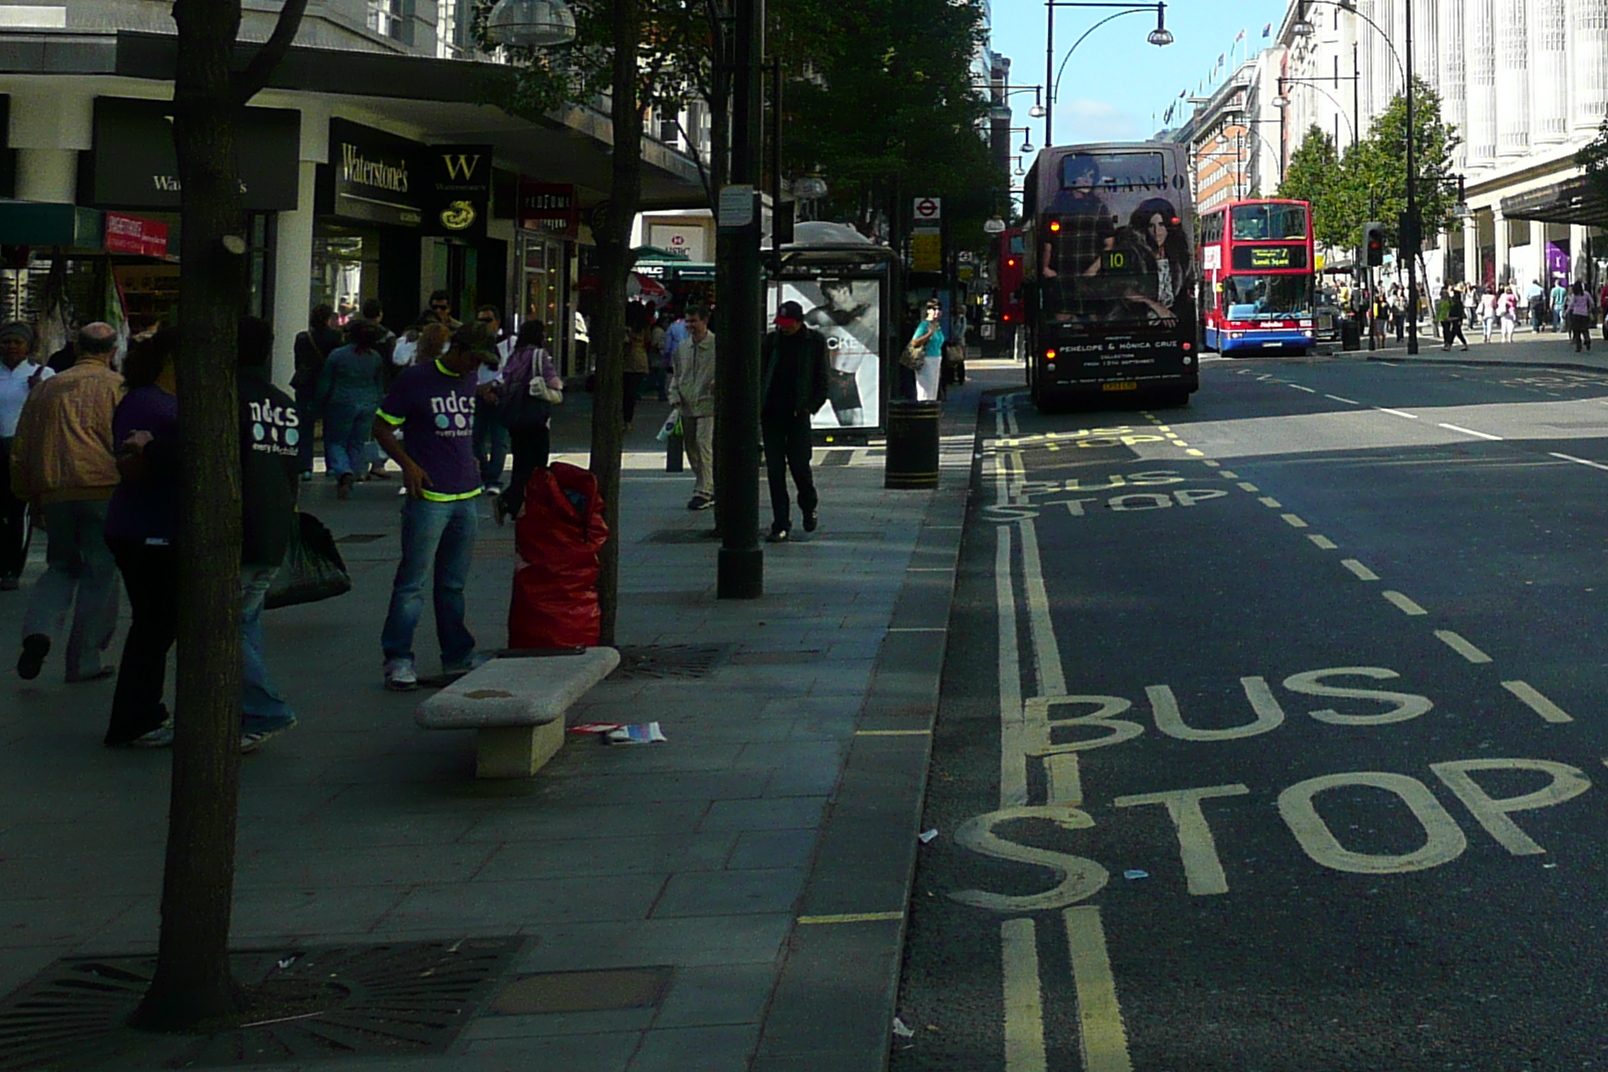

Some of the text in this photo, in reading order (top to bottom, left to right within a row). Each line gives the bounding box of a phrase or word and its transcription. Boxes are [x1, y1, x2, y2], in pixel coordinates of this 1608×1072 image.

[341, 142, 409, 194] Waterstone's
[441, 153, 482, 182] W
[1110, 253, 1124, 267] 10
[248, 397, 300, 428] ndcs
[430, 389, 476, 414] ndcs
[1010, 469, 1186, 498] BUS
[982, 488, 1229, 522] STOP
[1021, 666, 1435, 758] BUS
[947, 758, 1593, 913] STOP
